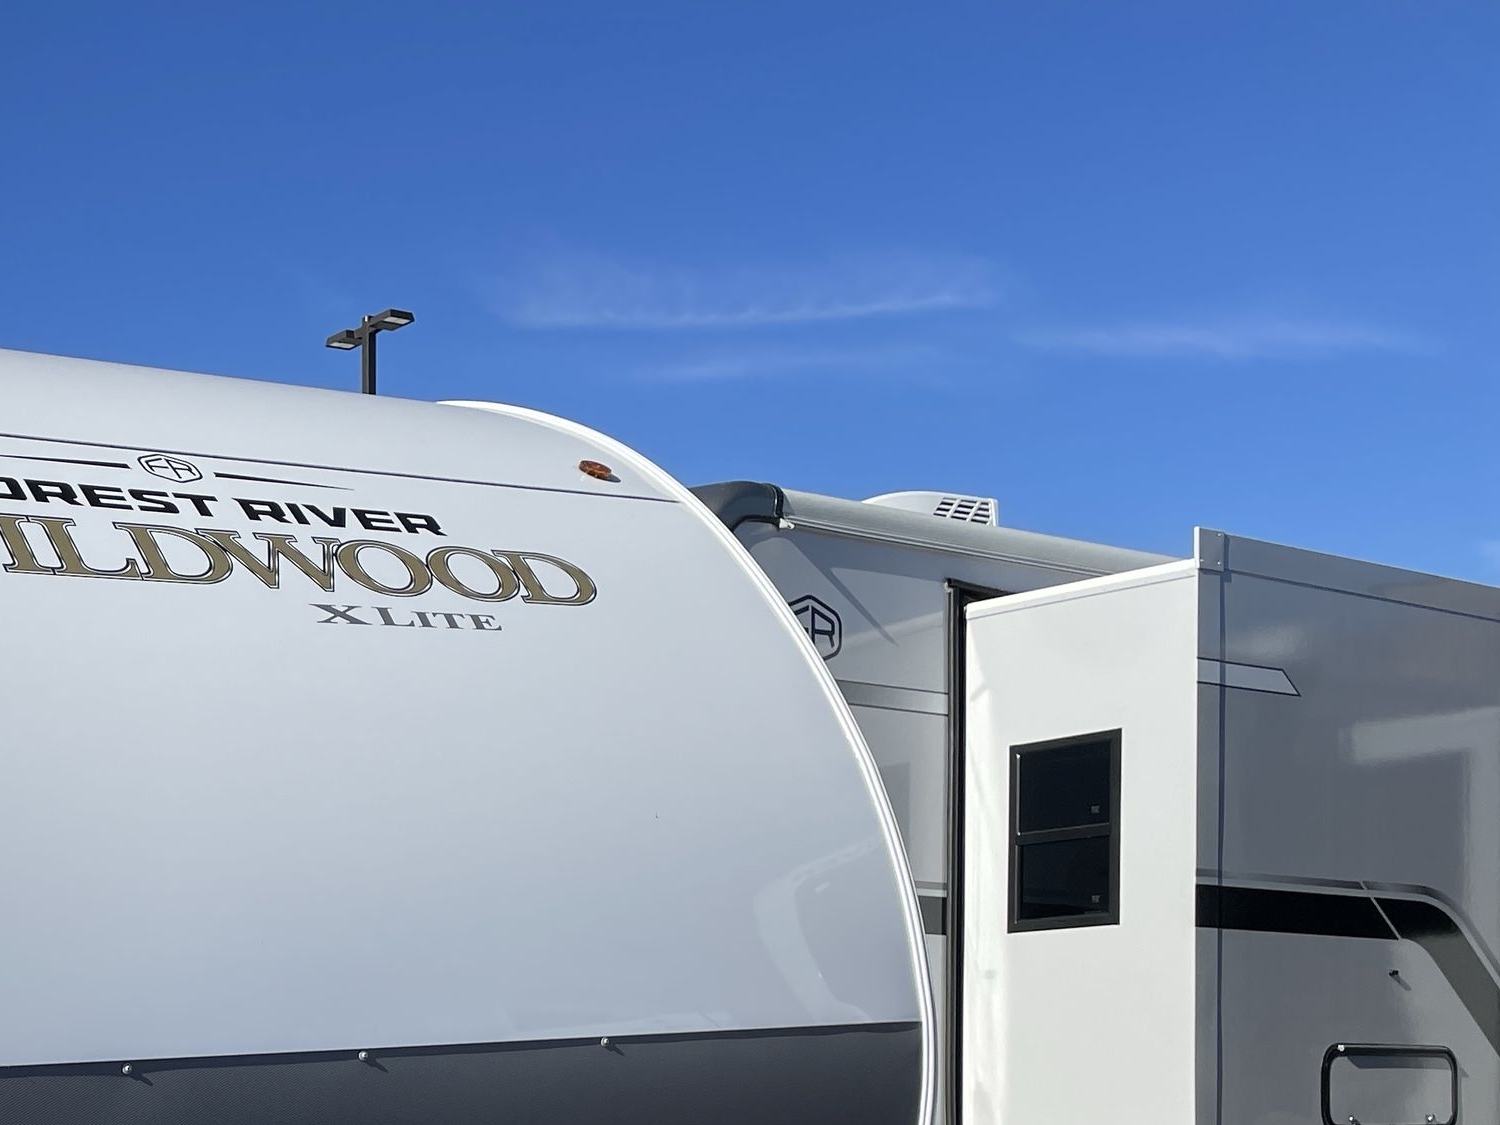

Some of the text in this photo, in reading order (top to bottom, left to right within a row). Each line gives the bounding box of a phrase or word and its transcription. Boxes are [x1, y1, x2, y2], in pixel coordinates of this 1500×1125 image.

[231, 497, 448, 537] RIVER
[309, 603, 502, 631] X LITE
